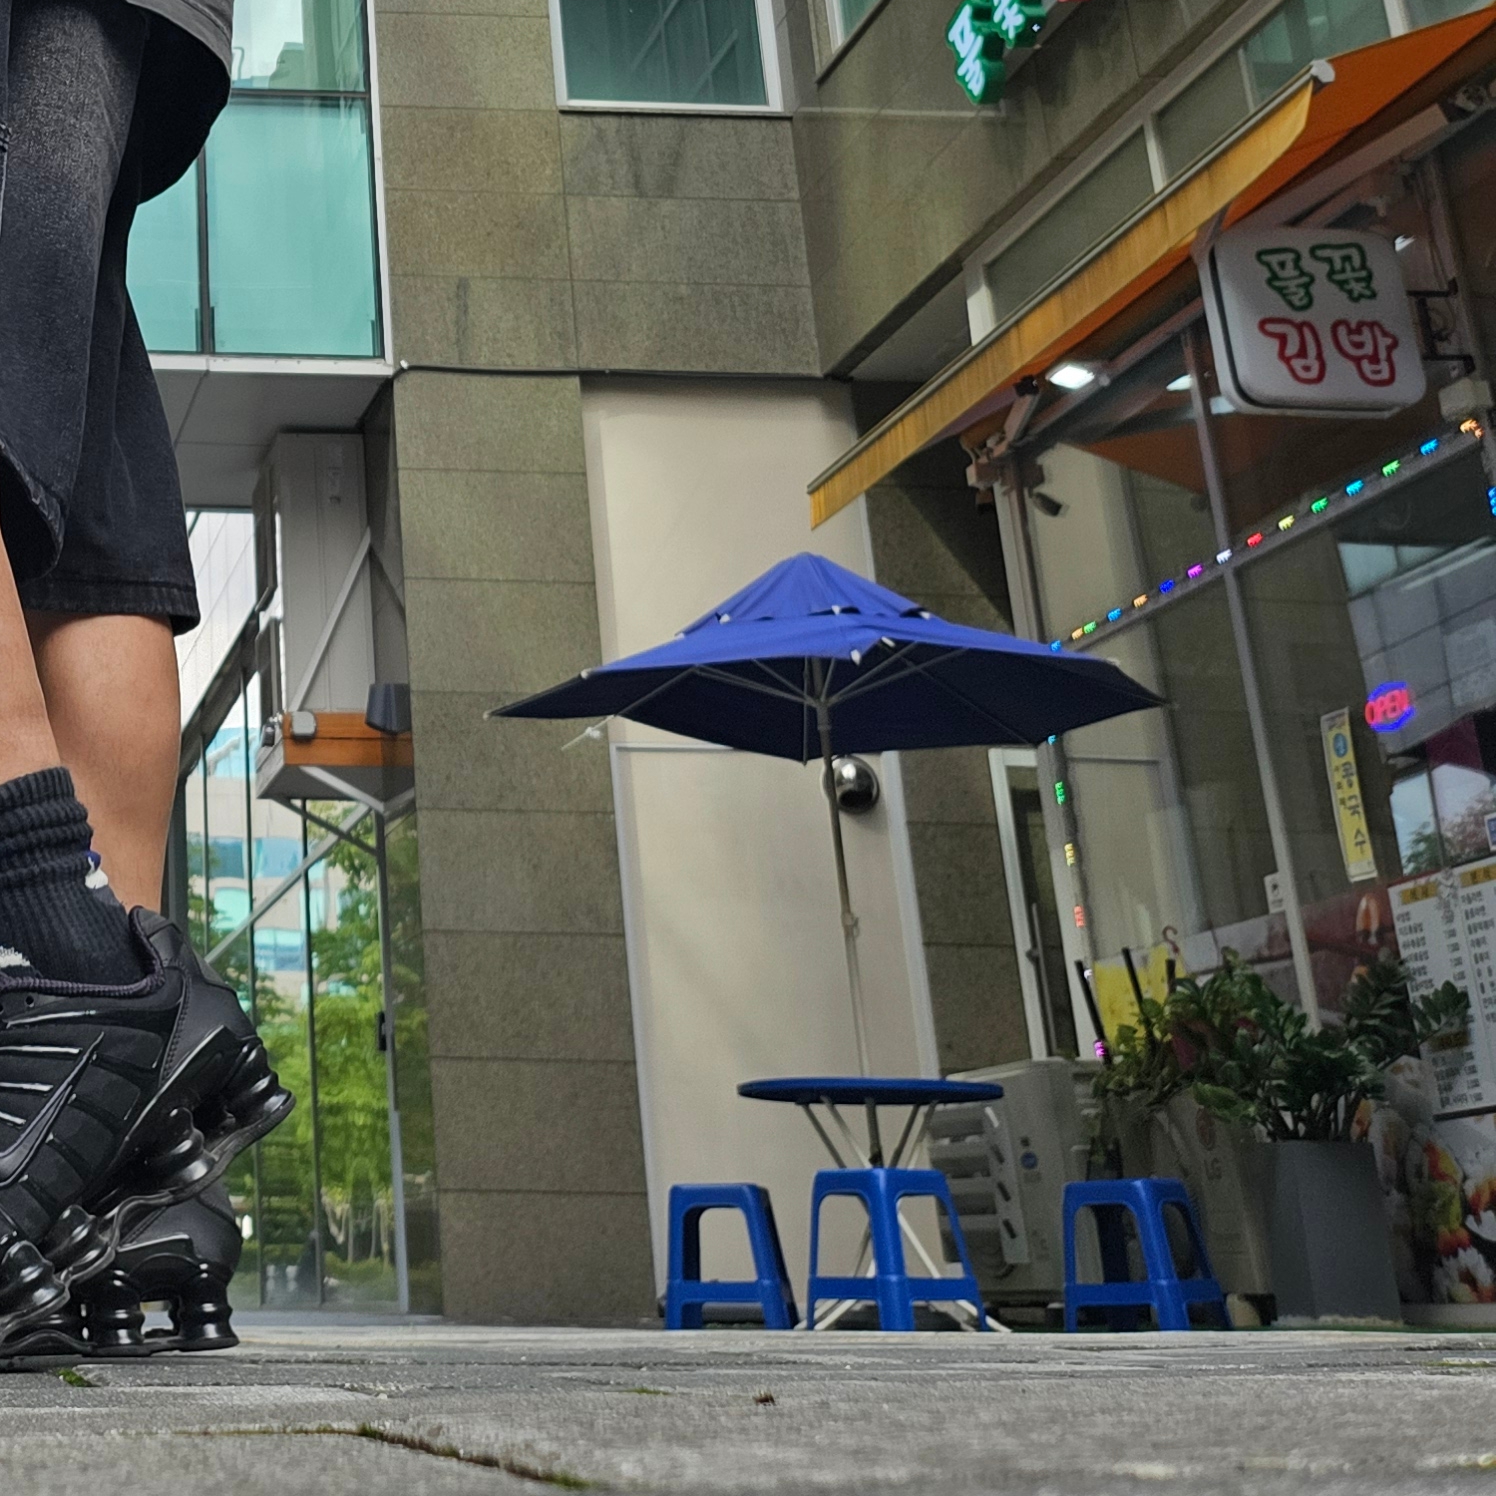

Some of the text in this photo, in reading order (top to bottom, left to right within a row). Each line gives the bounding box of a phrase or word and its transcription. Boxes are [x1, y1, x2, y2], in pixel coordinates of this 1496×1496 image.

[1255, 242, 1378, 312] 풀꽃
[1257, 316, 1400, 388] 김밥
[1364, 688, 1410, 725] OPEN
[1341, 760, 1367, 855] 콩국수
